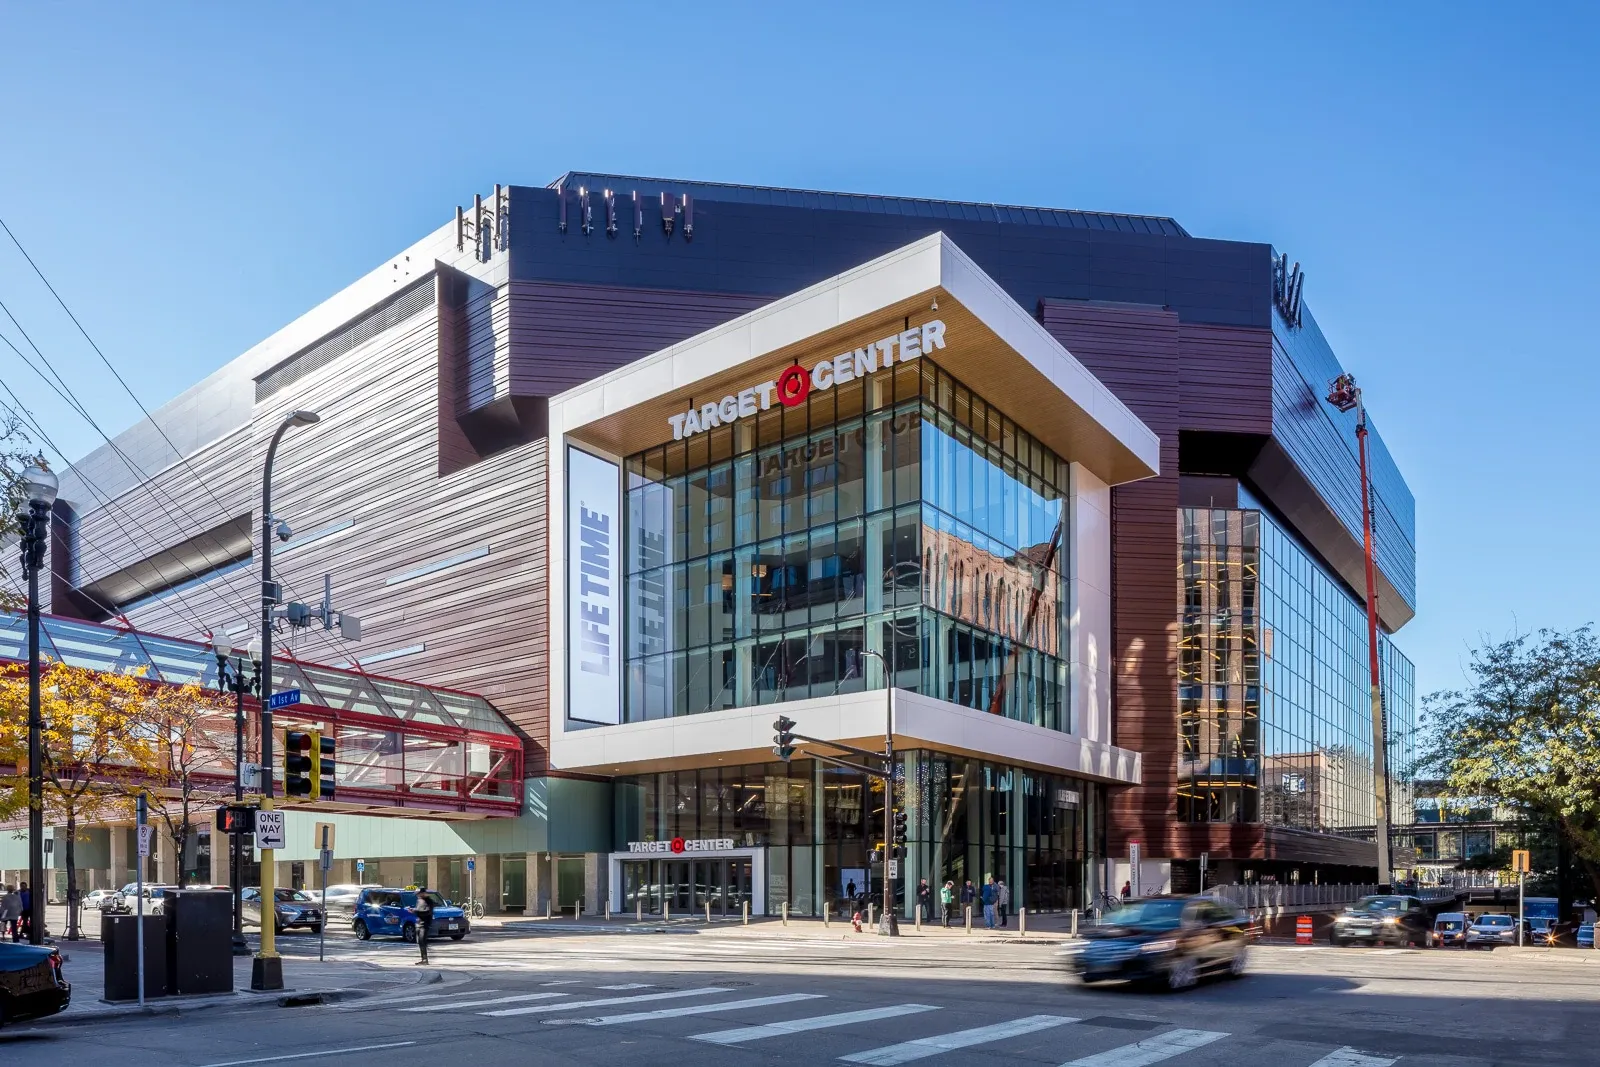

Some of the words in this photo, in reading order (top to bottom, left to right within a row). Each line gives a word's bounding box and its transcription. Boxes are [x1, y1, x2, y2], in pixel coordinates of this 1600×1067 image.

[668, 380, 777, 440] TARGET
[811, 319, 947, 391] CENTER
[580, 505, 610, 598] TIME
[580, 601, 610, 677] LIFE
[271, 697, 276, 706] N
[278, 696, 288, 704] 1st
[290, 692, 298, 702] Av
[260, 814, 280, 822] ONE
[260, 825, 280, 833] WAY
[627, 841, 671, 853] TARGET
[684, 838, 734, 851] CENTER
